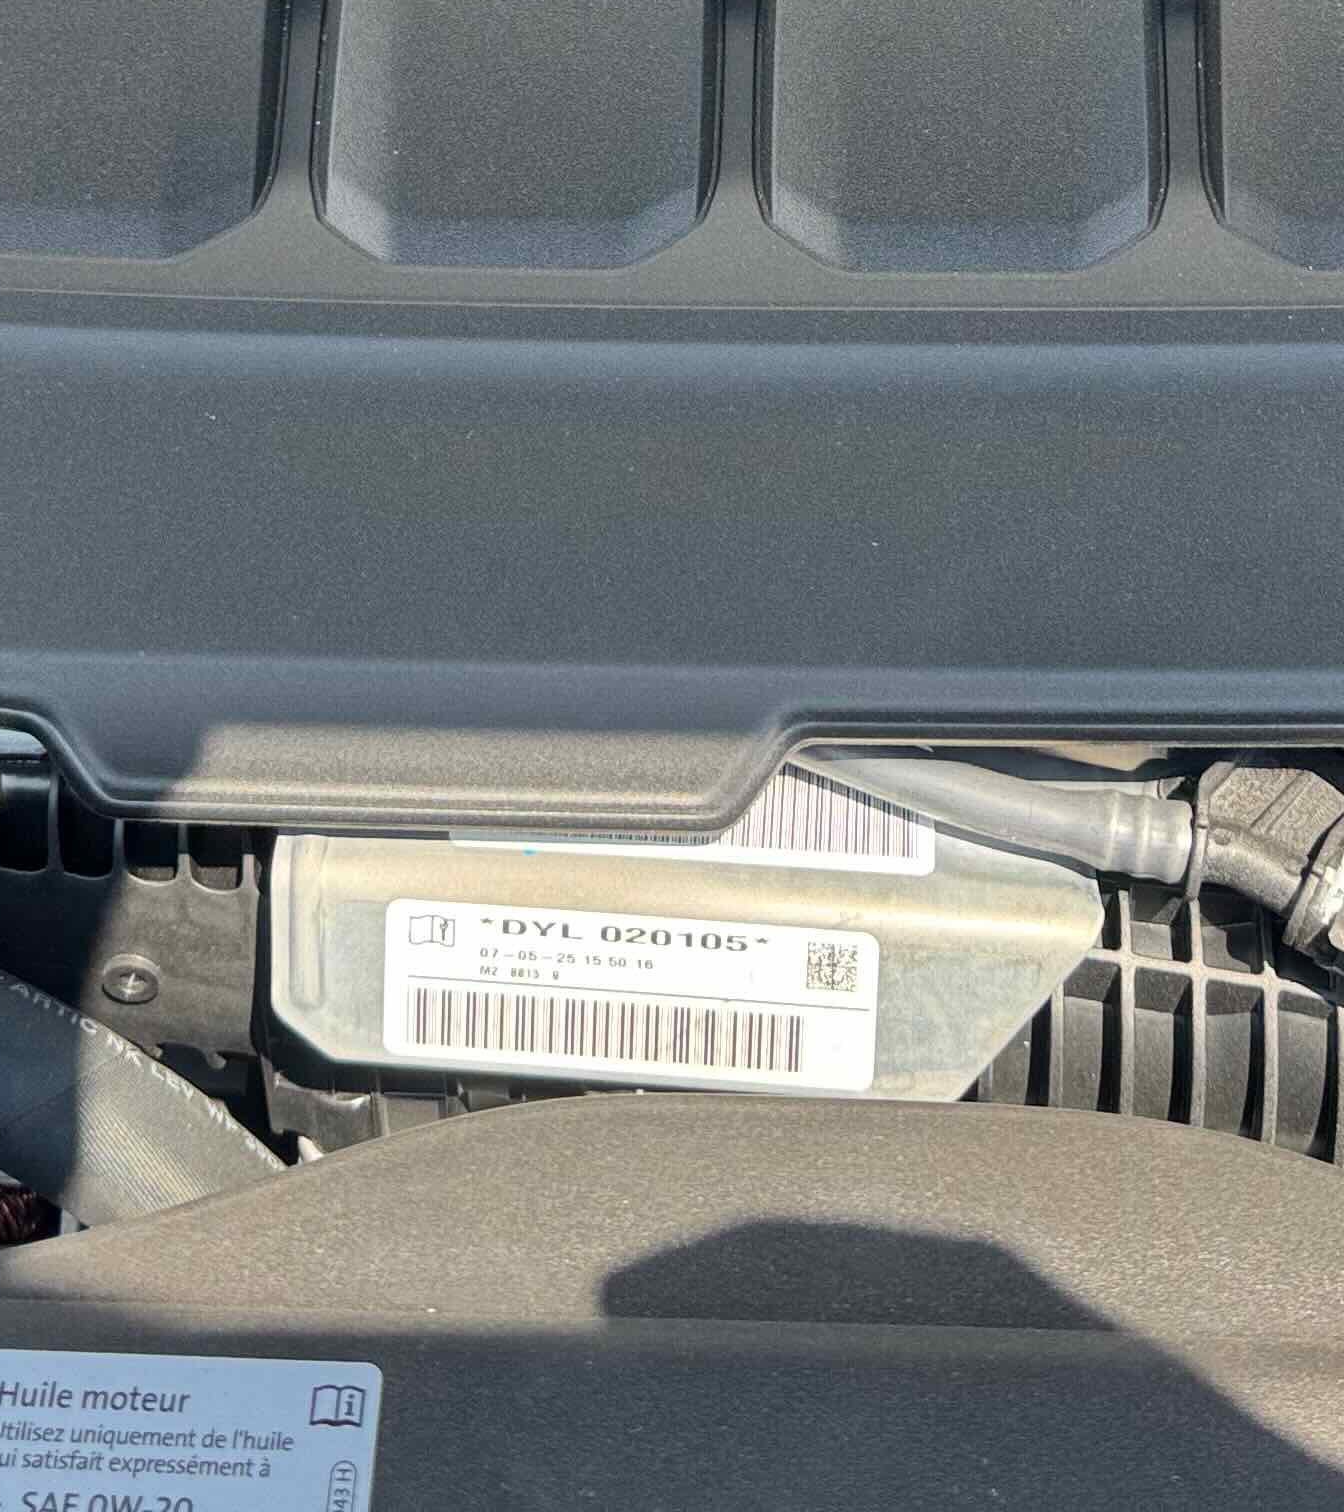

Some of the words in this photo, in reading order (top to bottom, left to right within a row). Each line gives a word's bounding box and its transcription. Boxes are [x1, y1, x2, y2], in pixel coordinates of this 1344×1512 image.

[81, 1387, 192, 1414] moteur
[70, 1424, 197, 1452] uniquement
[201, 1427, 227, 1450] de
[232, 1430, 295, 1453] l'huile
[21, 1450, 104, 1473] satisfait
[108, 1453, 254, 1479] expressément
[258, 1456, 272, 1479] à
[335, 1468, 352, 1482] H
[21, 1490, 81, 1512] SAE
